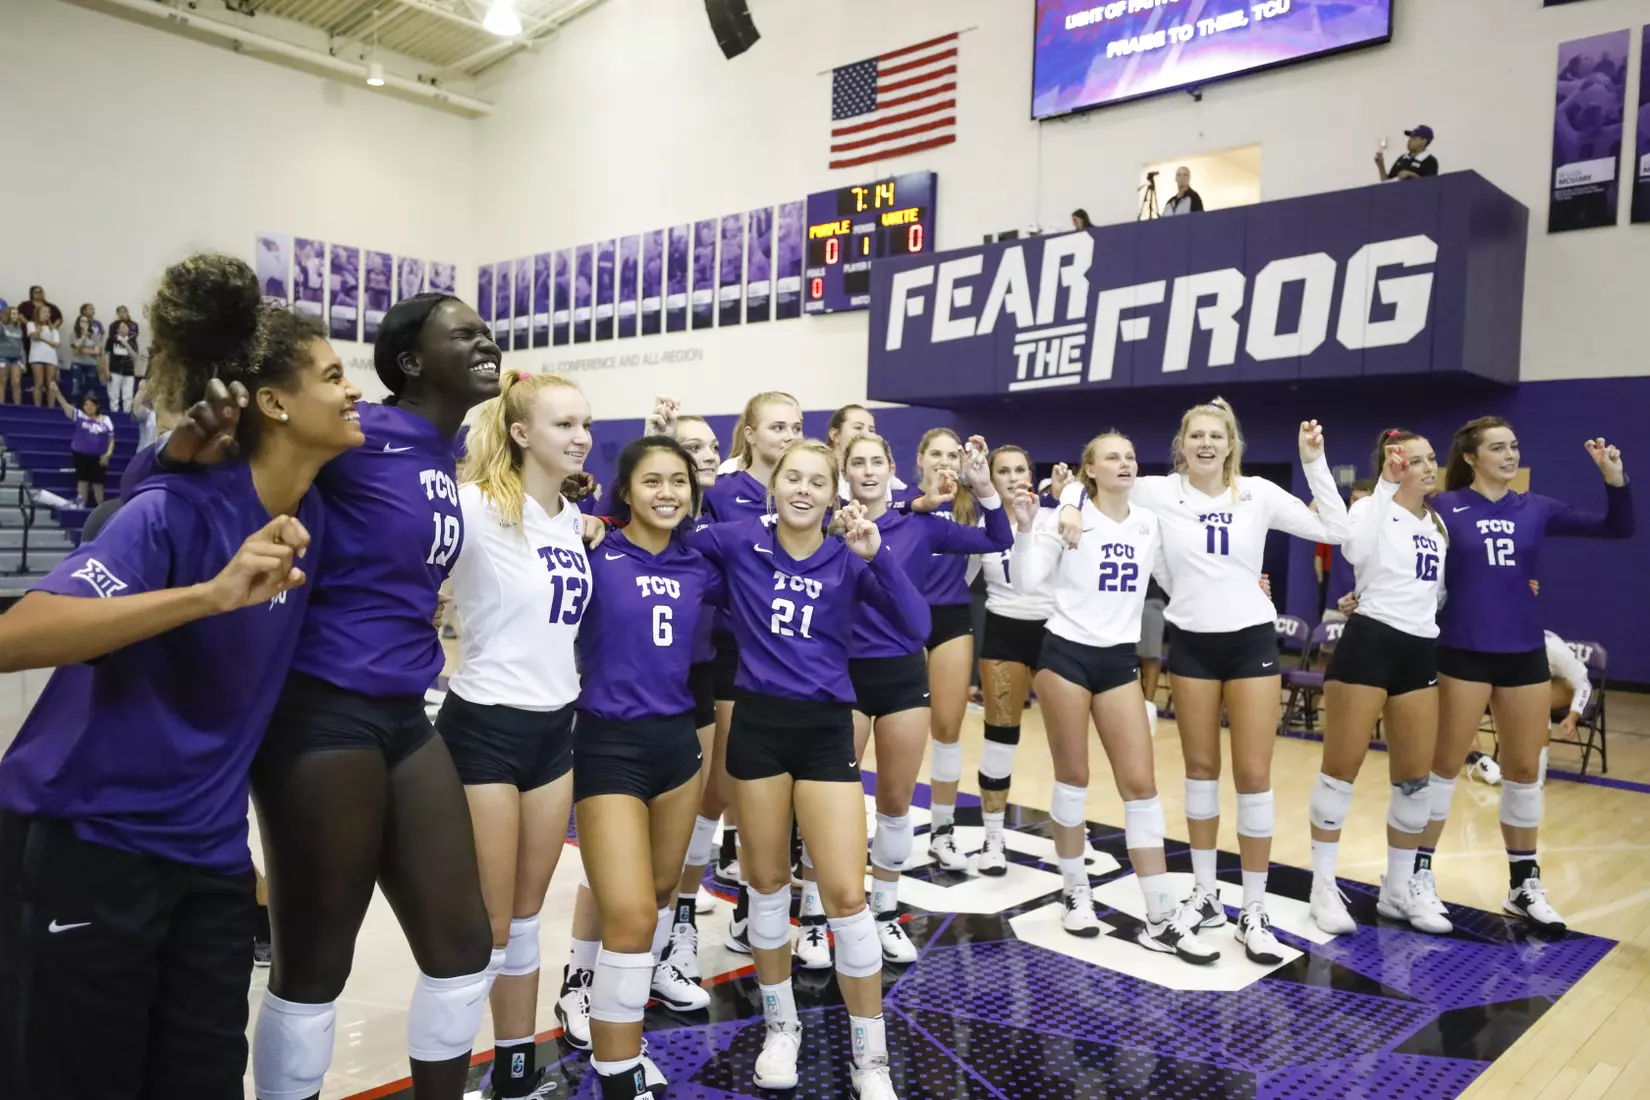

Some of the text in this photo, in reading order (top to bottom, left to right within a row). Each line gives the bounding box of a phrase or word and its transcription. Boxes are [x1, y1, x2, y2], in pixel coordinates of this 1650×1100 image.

[1065, 7, 1104, 30] LIGHT
[1104, 0, 1127, 19] OF
[1106, 30, 1166, 58] PRAISE
[1169, 24, 1194, 43] TO
[1251, 0, 1291, 21] TCU
[851, 182, 895, 212] 7:14
[809, 220, 851, 239] PURPLE
[881, 207, 919, 227] WHITE
[825, 237, 839, 265] 0
[908, 224, 923, 253] 0
[811, 276, 824, 299] 0
[886, 231, 1095, 351] FEAR
[1088, 234, 1439, 382] FROG
[619, 354, 640, 368] AND
[643, 348, 704, 365] ALL-REGION
[1013, 334, 1086, 380] THE
[419, 469, 458, 507] TCU
[1198, 512, 1233, 525] TCU
[1476, 519, 1516, 535] TCU
[426, 512, 460, 567] 19
[1101, 543, 1135, 560] TCU
[1206, 525, 1229, 556] 11
[1413, 534, 1438, 553] TCU
[1484, 538, 1516, 567] 12
[537, 545, 587, 574] TCU
[1415, 552, 1440, 581] 16
[636, 575, 681, 599] TCU
[773, 570, 823, 600] TCU
[1098, 562, 1139, 592] 22
[549, 575, 588, 625] 13
[652, 604, 673, 647] 6
[771, 598, 814, 639] 21
[1275, 617, 1299, 636] CU
[1326, 623, 1345, 640] TC
